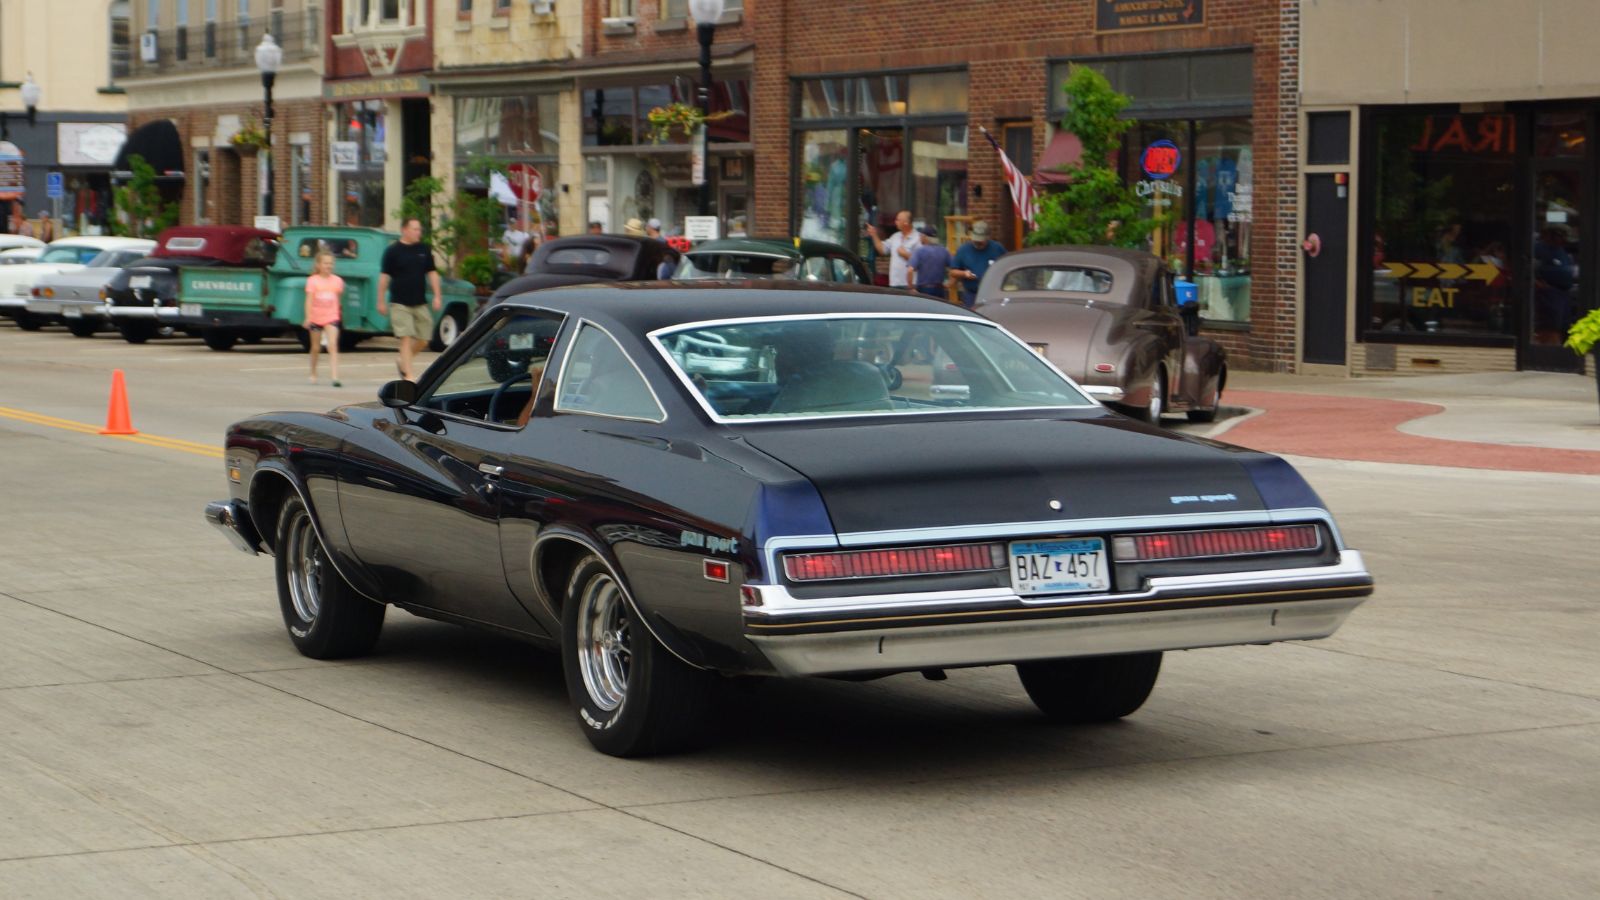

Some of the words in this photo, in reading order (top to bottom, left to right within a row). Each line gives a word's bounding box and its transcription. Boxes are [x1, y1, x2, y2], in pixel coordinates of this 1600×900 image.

[191, 280, 254, 292] CHEVROLET
[1411, 287, 1460, 308] EAT
[1015, 553, 1053, 581] BAZ
[1067, 550, 1099, 578] 457
